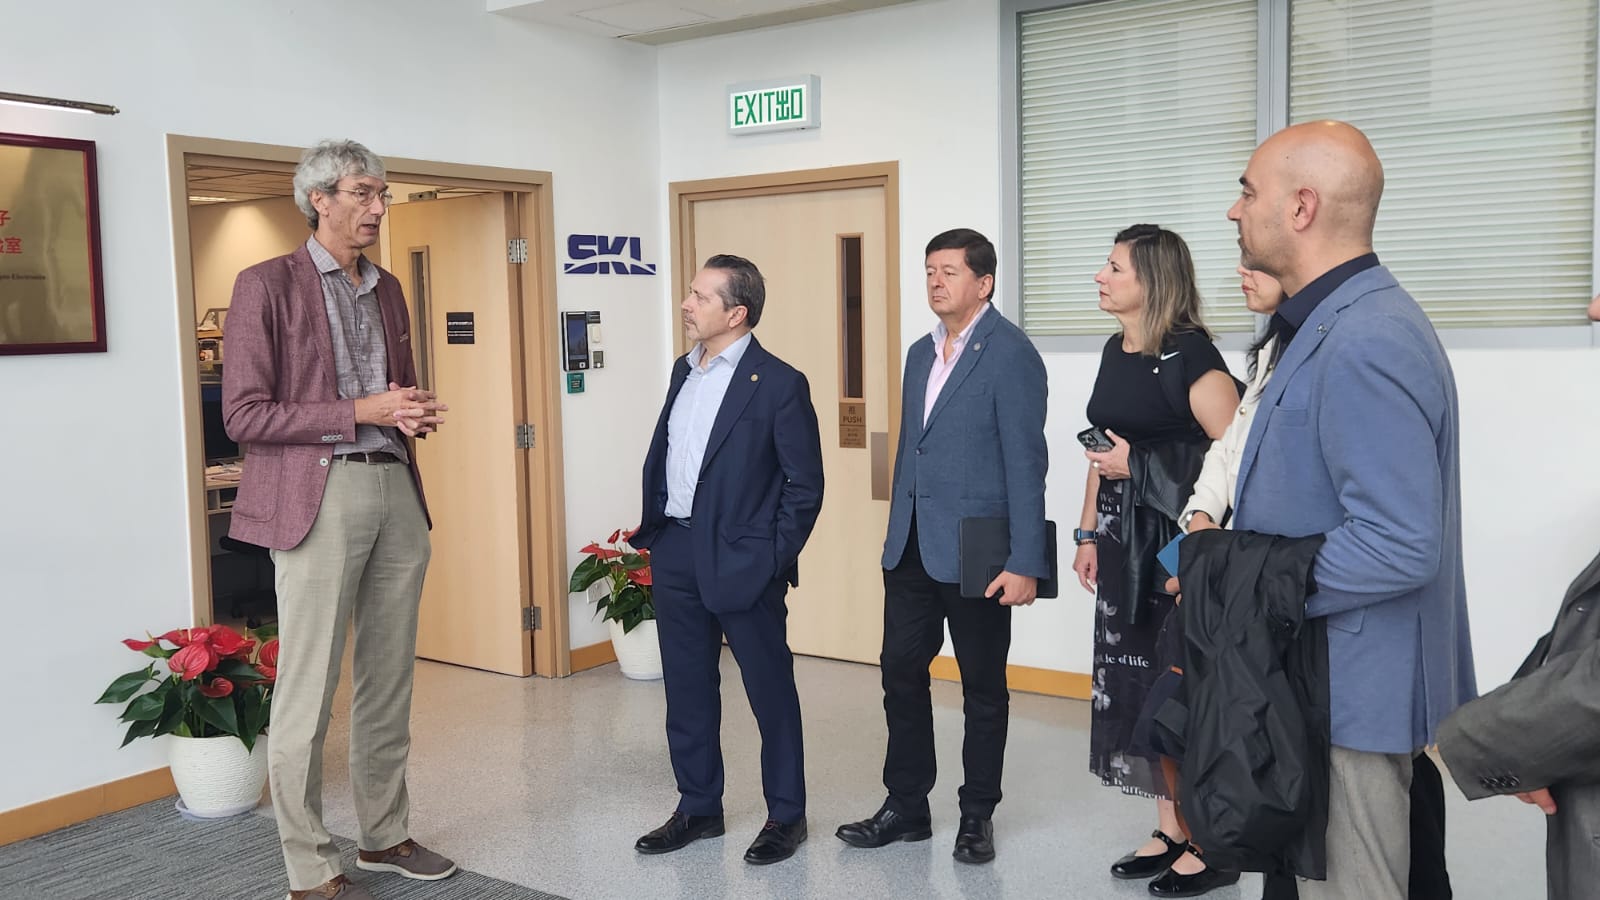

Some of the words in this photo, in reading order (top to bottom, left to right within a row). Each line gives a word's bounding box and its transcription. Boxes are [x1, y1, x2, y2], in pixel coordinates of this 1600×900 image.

[735, 92, 775, 126] EXIT
[564, 234, 656, 275] SKL
[842, 415, 862, 424] PUSH
[1128, 655, 1150, 668] life
